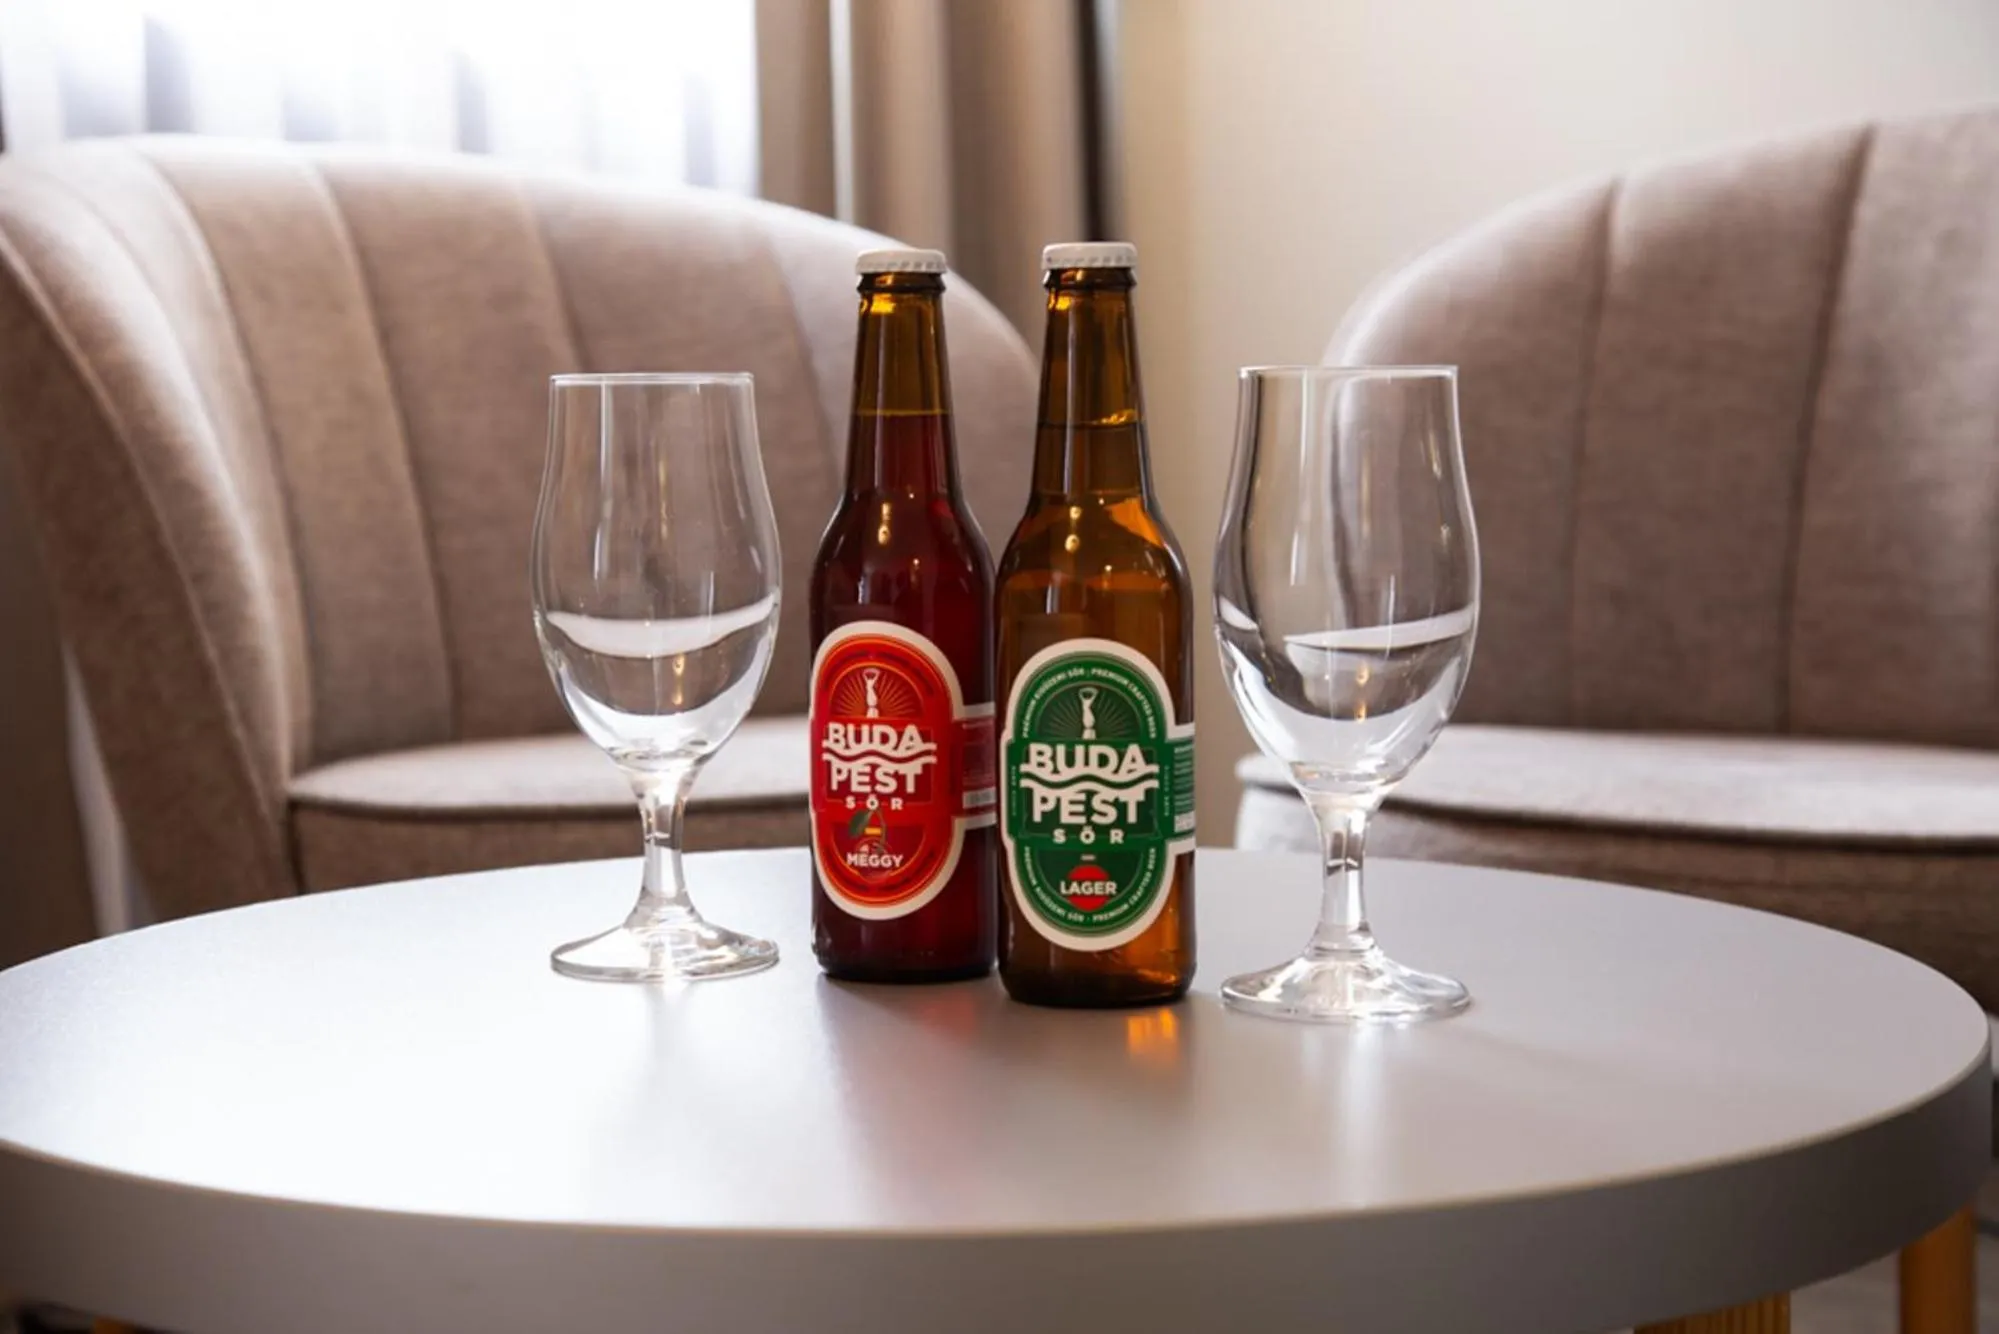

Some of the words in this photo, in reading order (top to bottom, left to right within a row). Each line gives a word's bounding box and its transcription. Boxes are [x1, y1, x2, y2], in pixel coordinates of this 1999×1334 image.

[825, 722, 928, 757] BUDA
[828, 758, 925, 794] PEST
[1024, 743, 1152, 782] BUDA
[1030, 787, 1147, 824] PEST
[846, 852, 904, 868] MEGGY
[1059, 881, 1118, 896] LAGER
